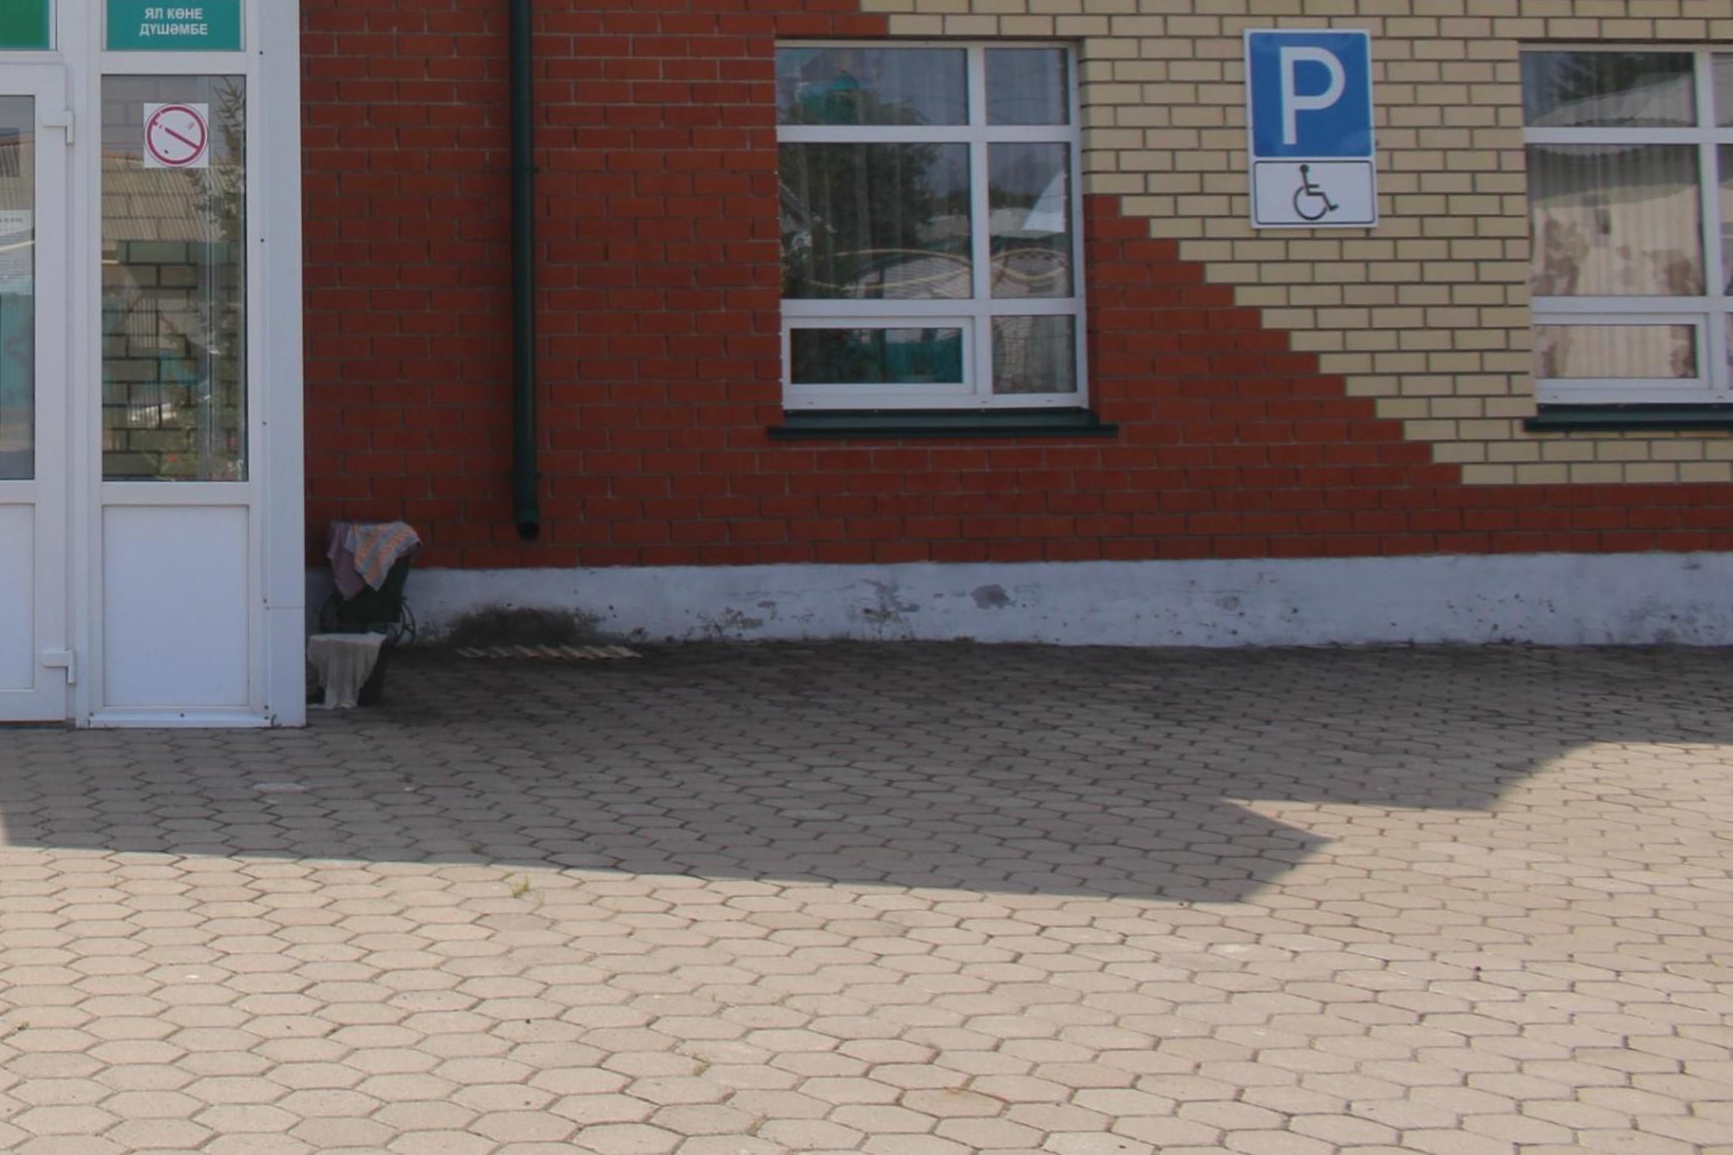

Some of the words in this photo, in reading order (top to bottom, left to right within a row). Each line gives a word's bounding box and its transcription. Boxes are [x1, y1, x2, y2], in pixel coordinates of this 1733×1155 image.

[144, 7, 164, 20] ЯЛ
[167, 7, 204, 20] КӨНЕ
[139, 23, 208, 37] ДҮШӘМБЕ
[1280, 46, 1346, 145] P
